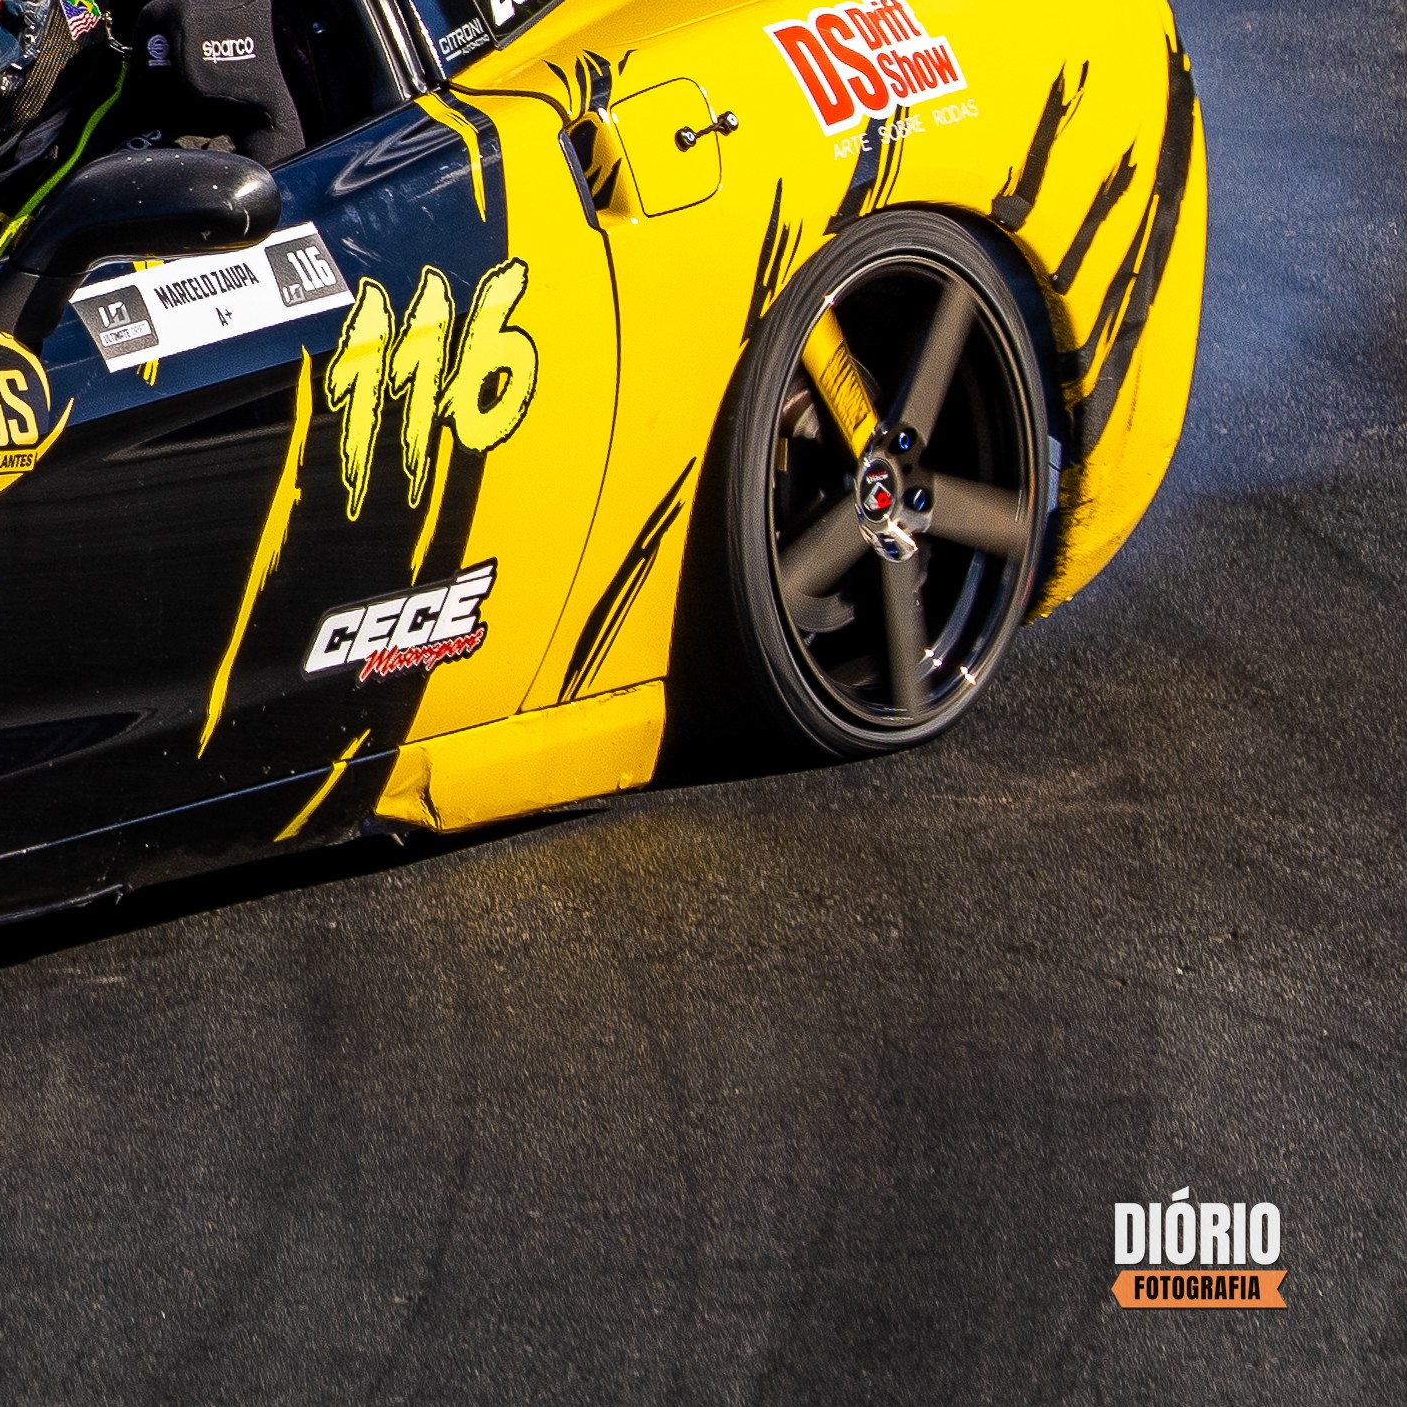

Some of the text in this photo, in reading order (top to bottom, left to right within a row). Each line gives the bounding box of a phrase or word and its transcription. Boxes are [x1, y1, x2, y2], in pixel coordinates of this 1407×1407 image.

[202, 36, 255, 63] sparco
[438, 17, 485, 55] CITRONI
[773, 13, 889, 126] DS
[877, 45, 959, 98] Show
[833, 98, 979, 160] ARTE SOBRE RODAS
[154, 262, 259, 310] MARCELO ZAUPA
[286, 245, 336, 293] 116
[215, 306, 233, 327] A+
[326, 258, 538, 521] 116
